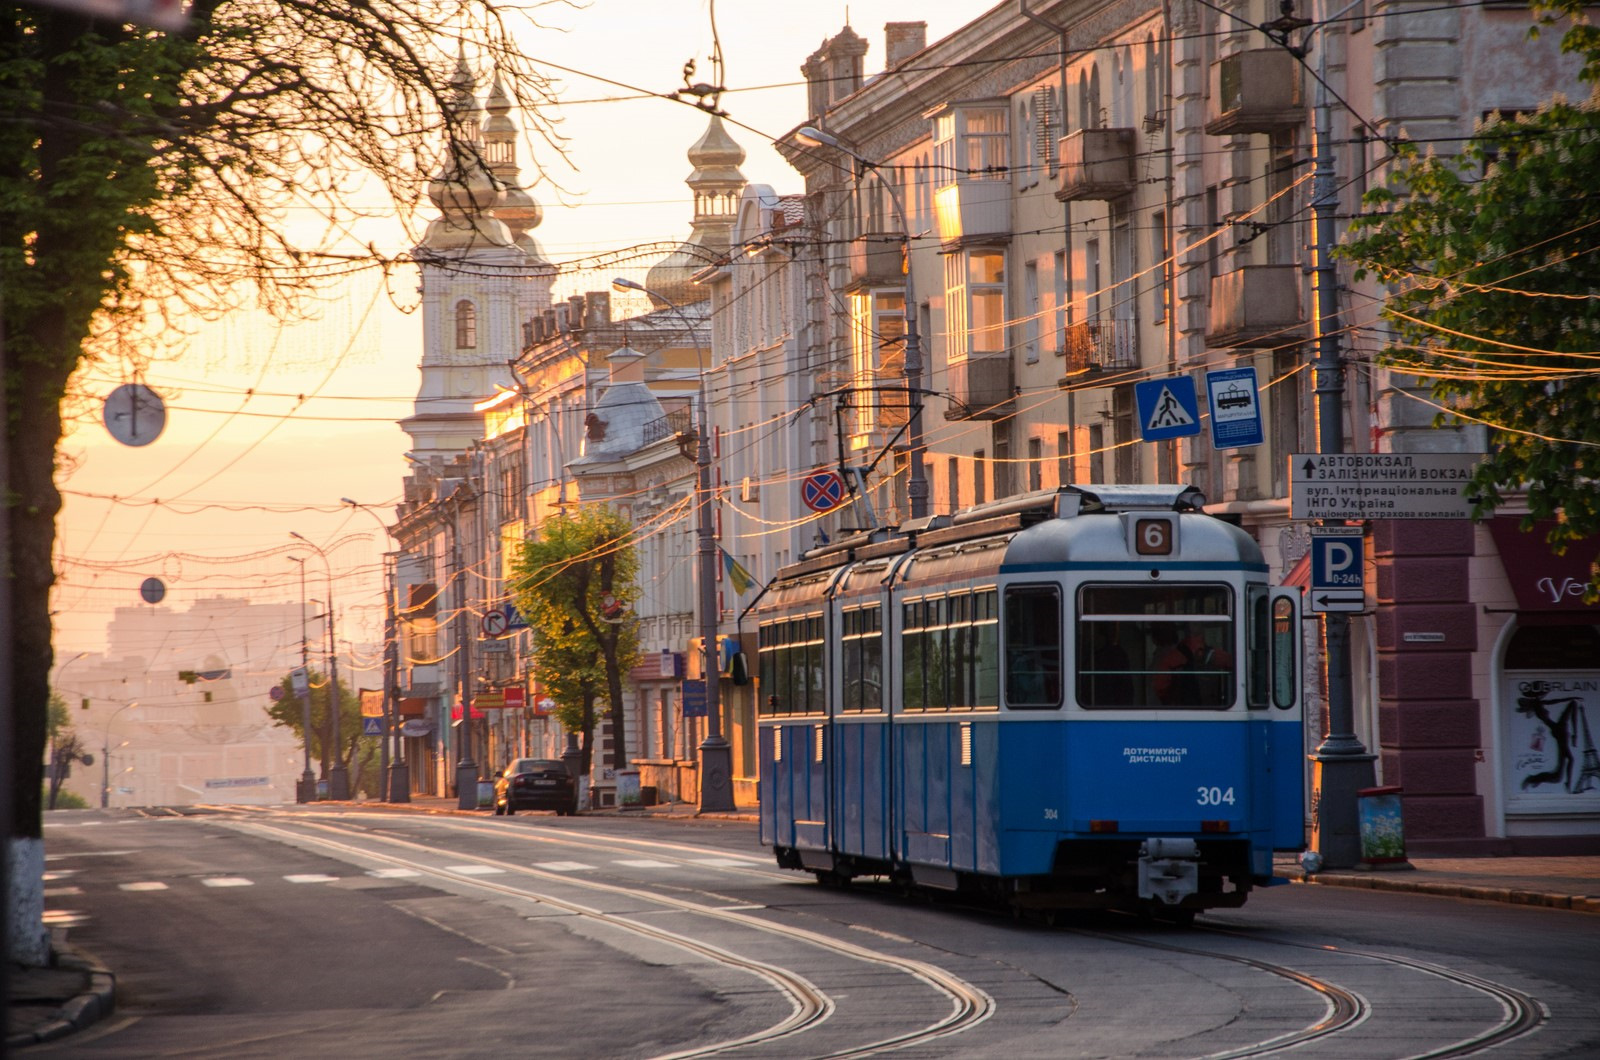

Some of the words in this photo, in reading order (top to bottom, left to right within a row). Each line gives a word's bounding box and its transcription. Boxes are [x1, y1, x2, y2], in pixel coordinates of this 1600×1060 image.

[1318, 456, 1413, 467] АВТОВОКЗАЛ
[1318, 467, 1417, 480] ЗАЛІЗНИЧНИЙ
[1306, 487, 1333, 498] вул.
[1336, 485, 1458, 498] Інтернаціональна
[1307, 497, 1337, 508] ІНГО
[1342, 498, 1395, 510] Україна
[1307, 510, 1366, 519] Акціонерна
[1369, 511, 1416, 519] страхова
[1418, 509, 1466, 518] компанія
[1144, 523, 1164, 548] 6
[1324, 542, 1354, 583] P
[1517, 680, 1598, 693] GUERLAIN
[1123, 746, 1188, 756] ДОТРИМУЙСЯ
[1129, 755, 1182, 765] ДИСТАНЦІЇ
[1196, 786, 1236, 806] 304
[1043, 808, 1058, 820] 304
